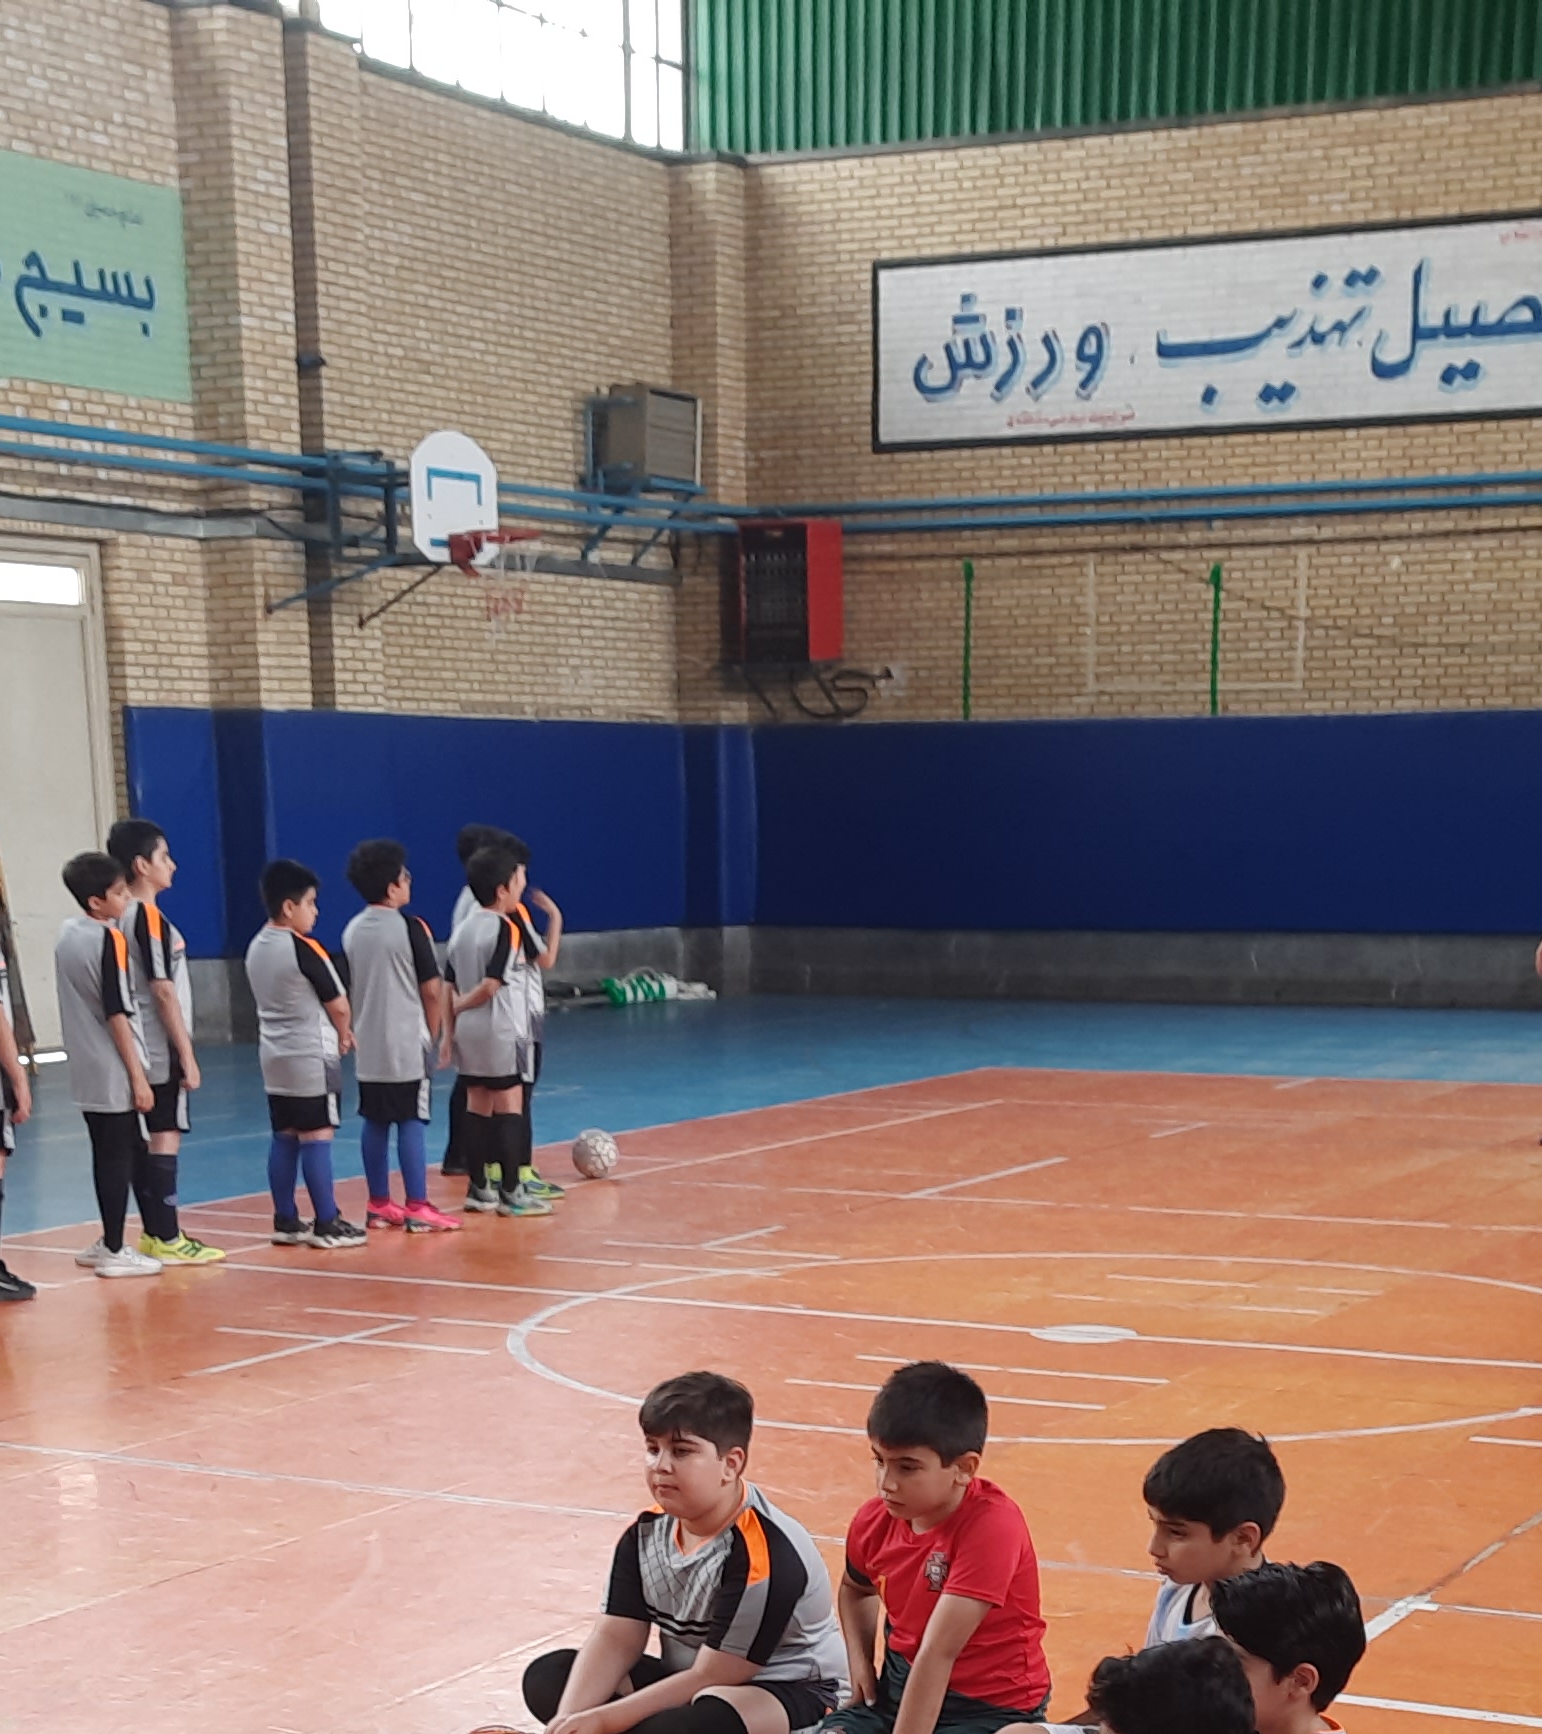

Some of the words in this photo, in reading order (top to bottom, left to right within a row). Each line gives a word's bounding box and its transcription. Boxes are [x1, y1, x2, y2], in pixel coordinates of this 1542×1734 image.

[15, 250, 156, 338] بسیج
[914, 293, 1109, 401] ورزش
[1155, 266, 1379, 408] تهذیب
